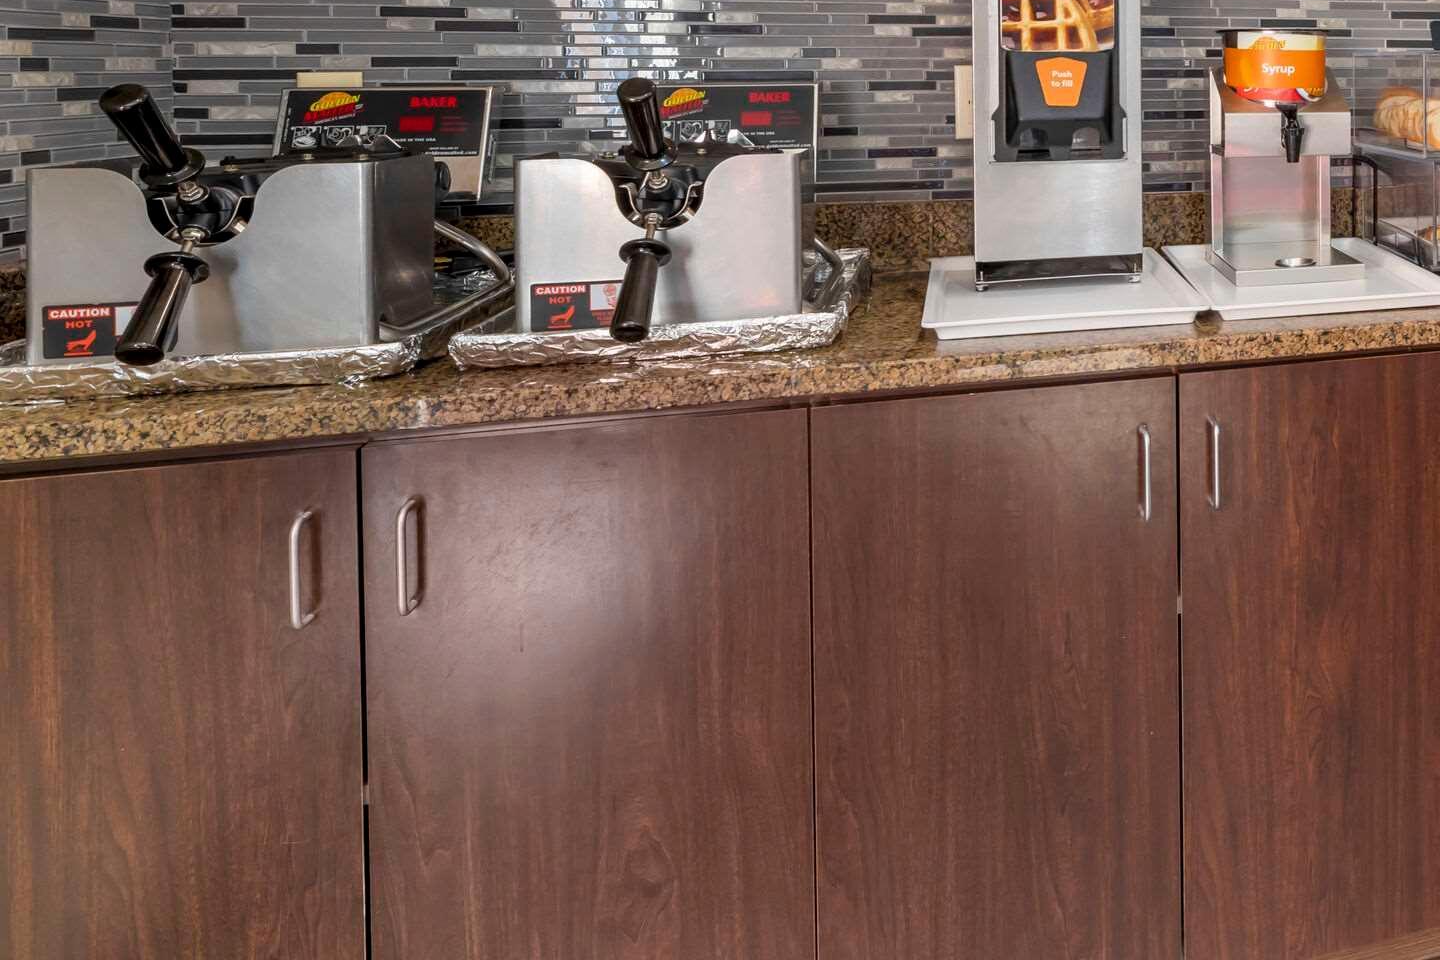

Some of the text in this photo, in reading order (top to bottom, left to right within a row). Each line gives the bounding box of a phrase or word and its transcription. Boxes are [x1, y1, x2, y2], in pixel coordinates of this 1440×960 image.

[1051, 70, 1073, 78] Push
[1262, 63, 1296, 76] Syrup
[1062, 79, 1073, 87] fill
[409, 96, 457, 108] BAKER
[748, 91, 791, 103] BAKER
[535, 285, 586, 295] CAUTION
[549, 296, 571, 305] HOT
[49, 307, 111, 319] CAUTION
[65, 320, 93, 329] HOT
